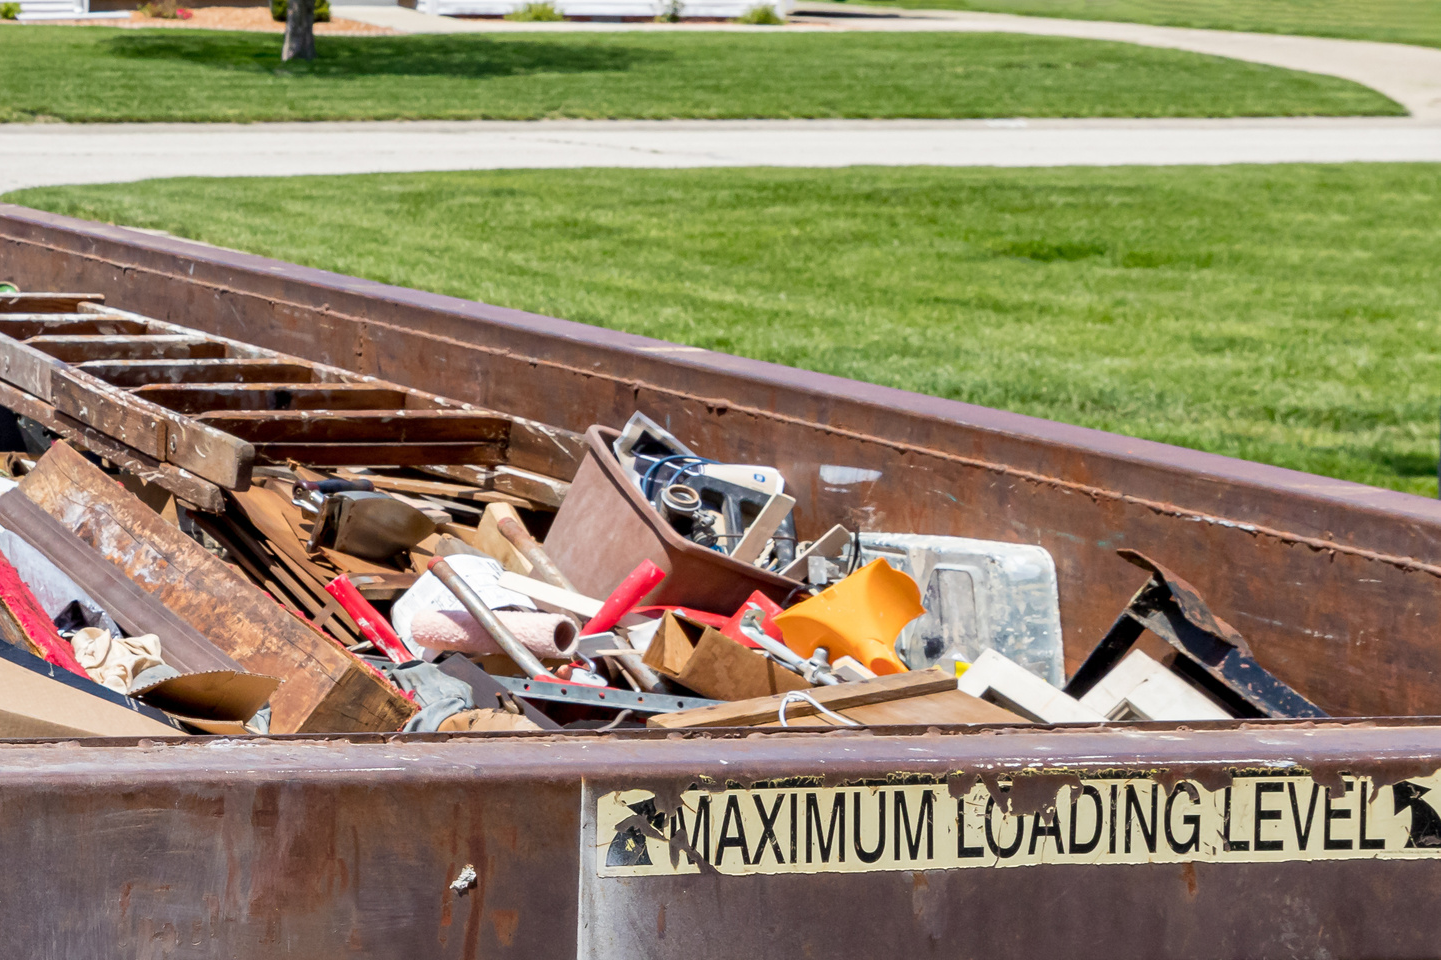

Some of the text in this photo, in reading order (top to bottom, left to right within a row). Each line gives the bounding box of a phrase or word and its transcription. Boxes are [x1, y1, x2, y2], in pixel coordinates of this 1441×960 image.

[670, 781, 1387, 866] MAXIMUM LOADING LEVEL
